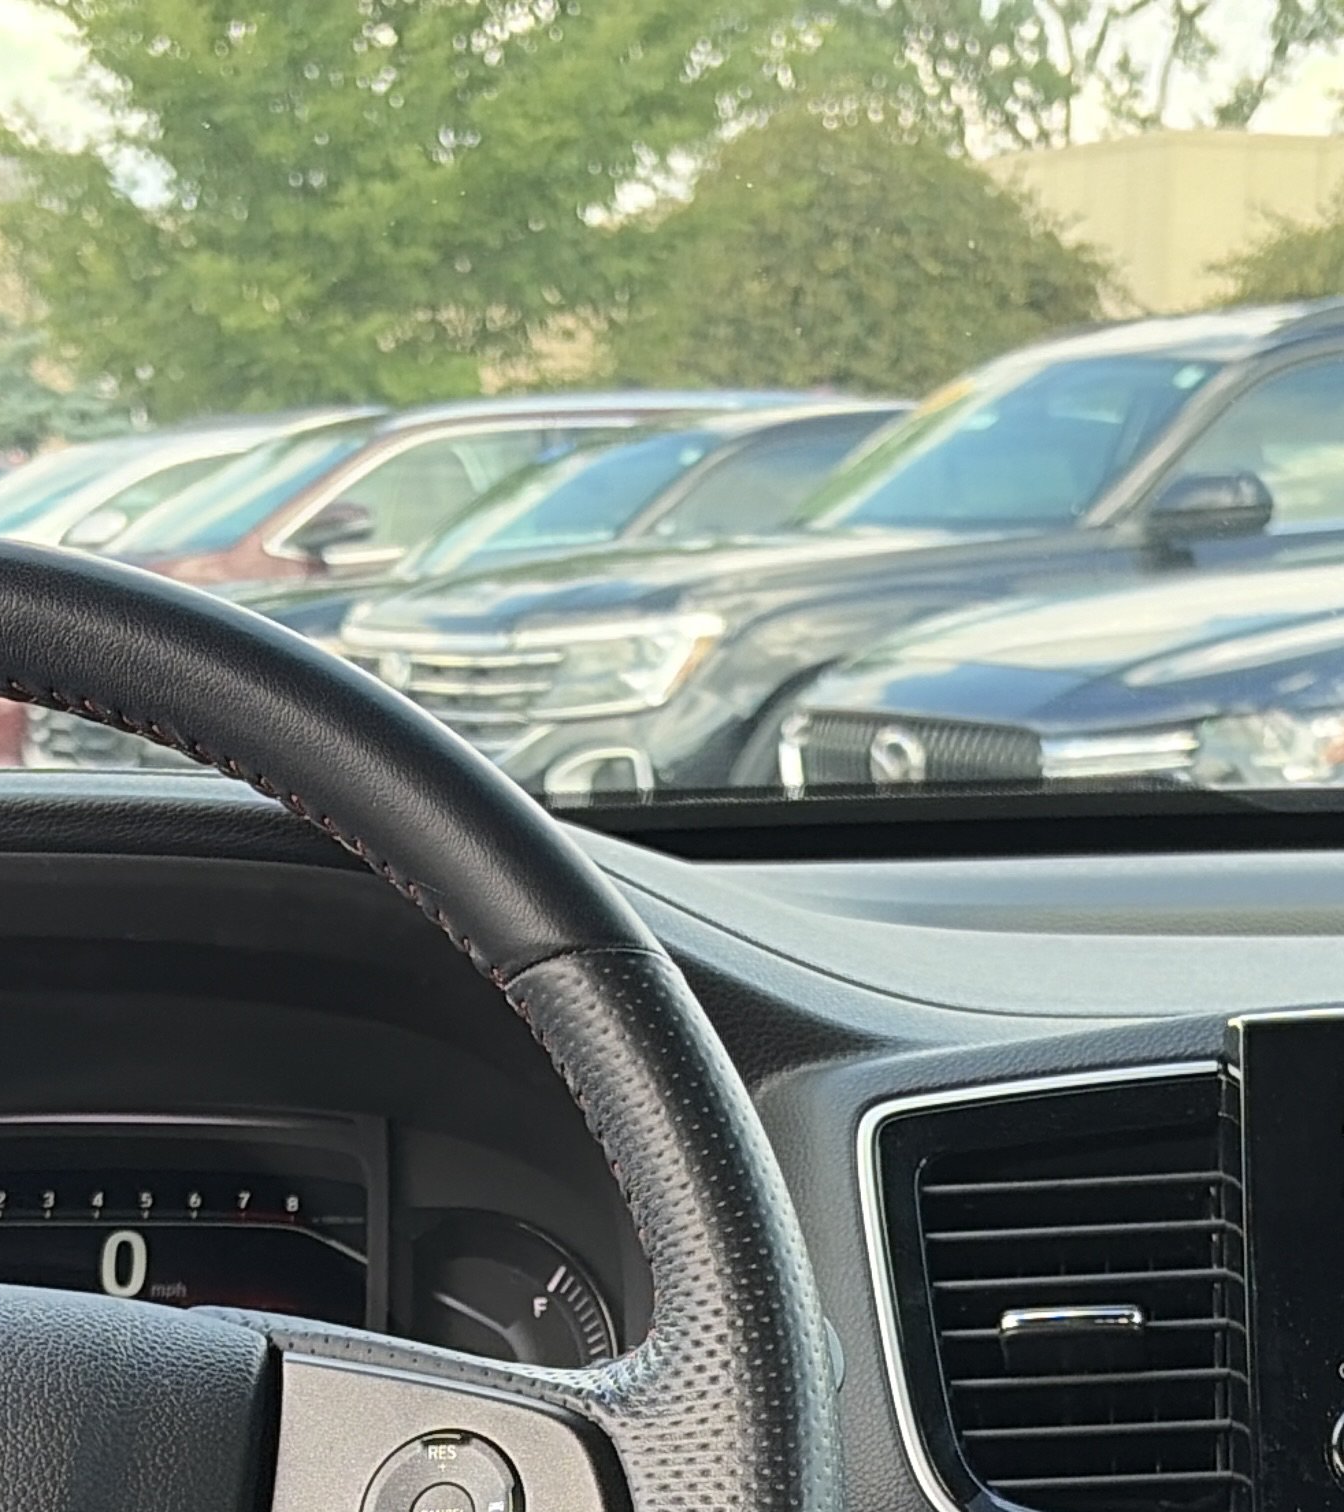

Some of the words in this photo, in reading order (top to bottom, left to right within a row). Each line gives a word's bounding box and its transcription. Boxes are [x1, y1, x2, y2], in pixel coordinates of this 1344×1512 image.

[43, 1191, 56, 1209] 3
[92, 1191, 105, 1209] 4
[140, 1191, 153, 1209] 5
[189, 1191, 202, 1209] 6
[239, 1192, 252, 1209] 7
[286, 1195, 299, 1213] 8
[101, 1229, 147, 1298] 0
[151, 1281, 187, 1299] mph
[533, 1296, 549, 1318] F
[427, 1445, 457, 1460] RES
